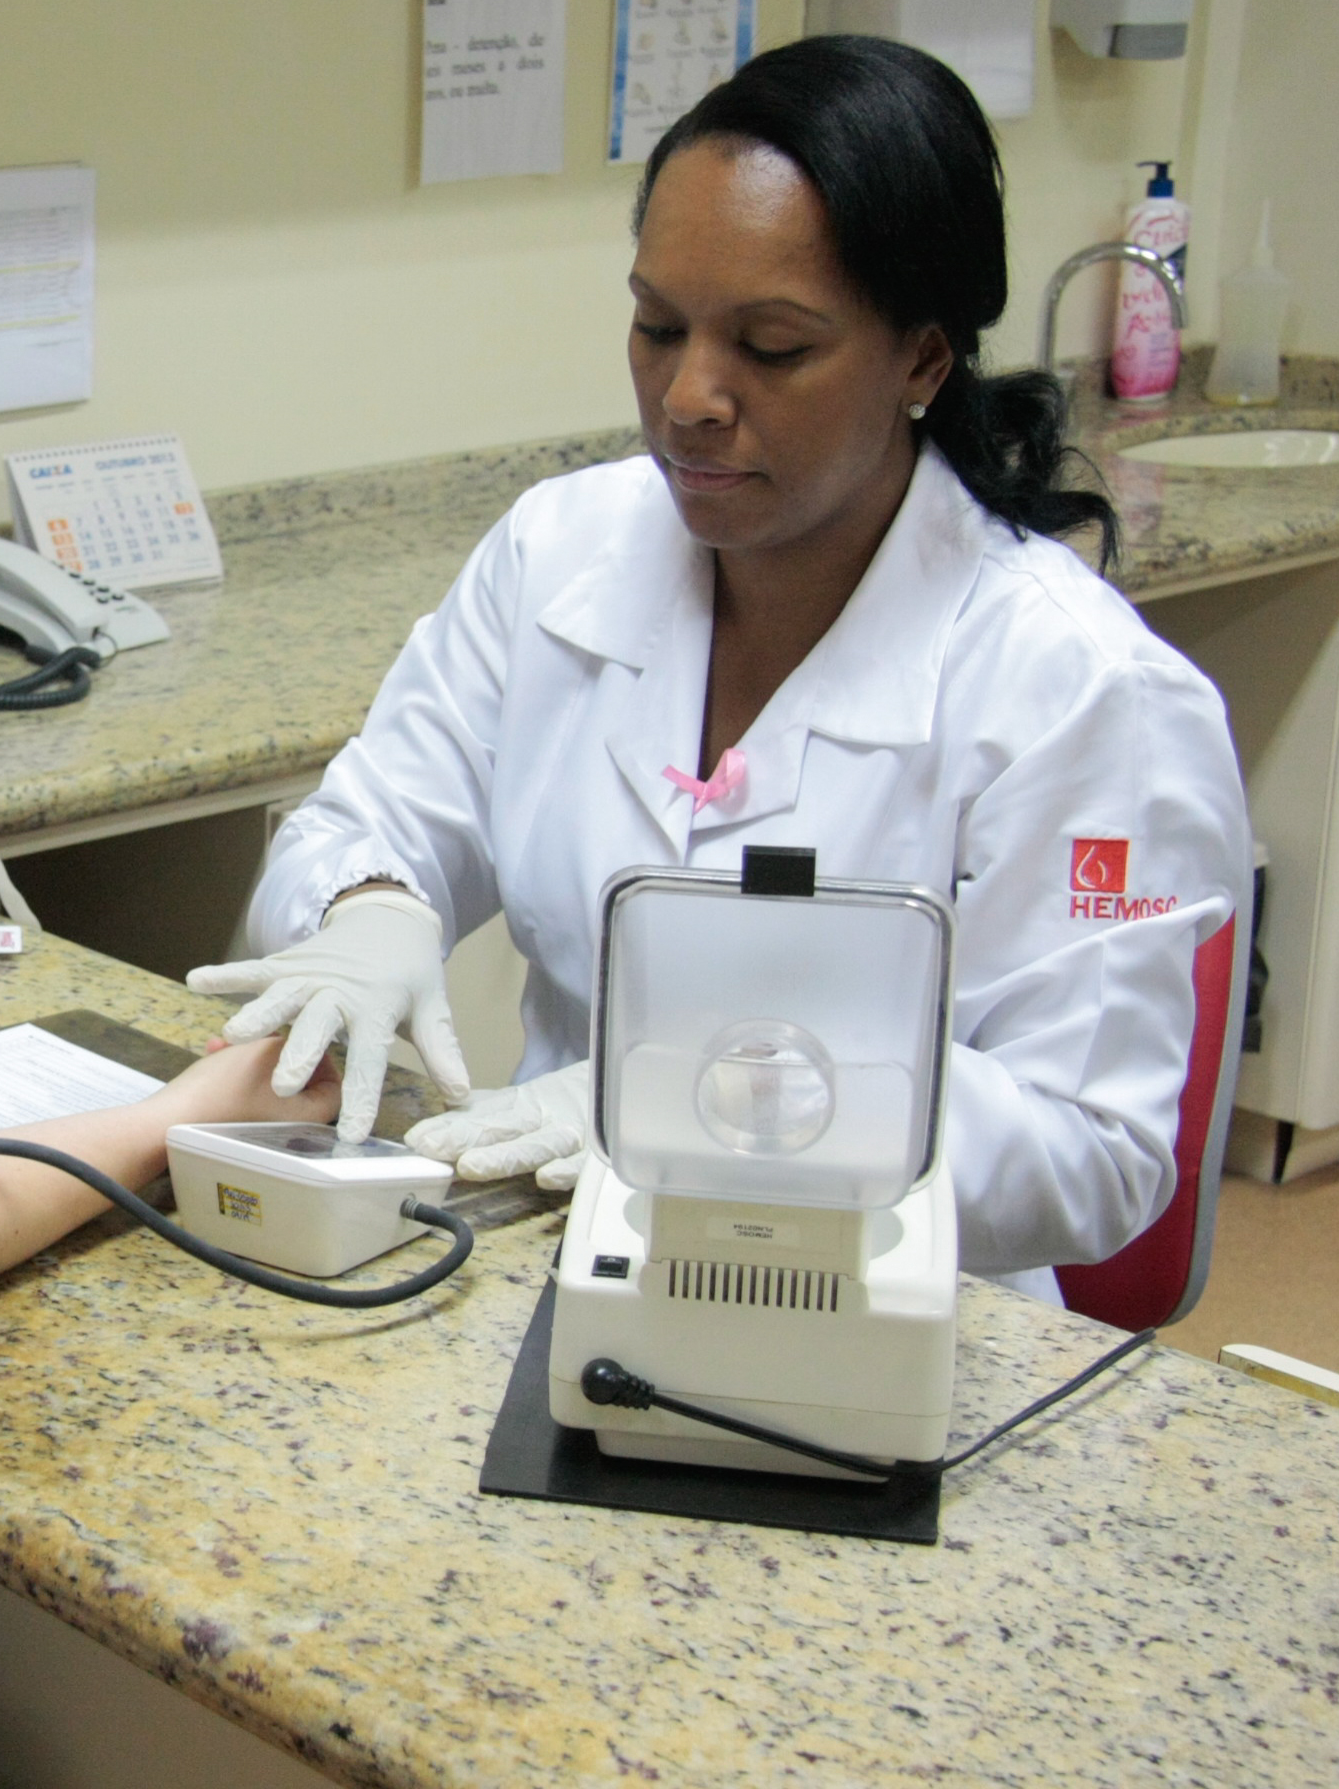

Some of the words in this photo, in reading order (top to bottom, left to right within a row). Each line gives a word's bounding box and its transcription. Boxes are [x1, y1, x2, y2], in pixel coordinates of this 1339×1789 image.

[452, 62, 486, 75] meses
[517, 54, 544, 70] dois
[30, 464, 72, 479] CAIXA
[96, 456, 146, 471] OUTUBRO
